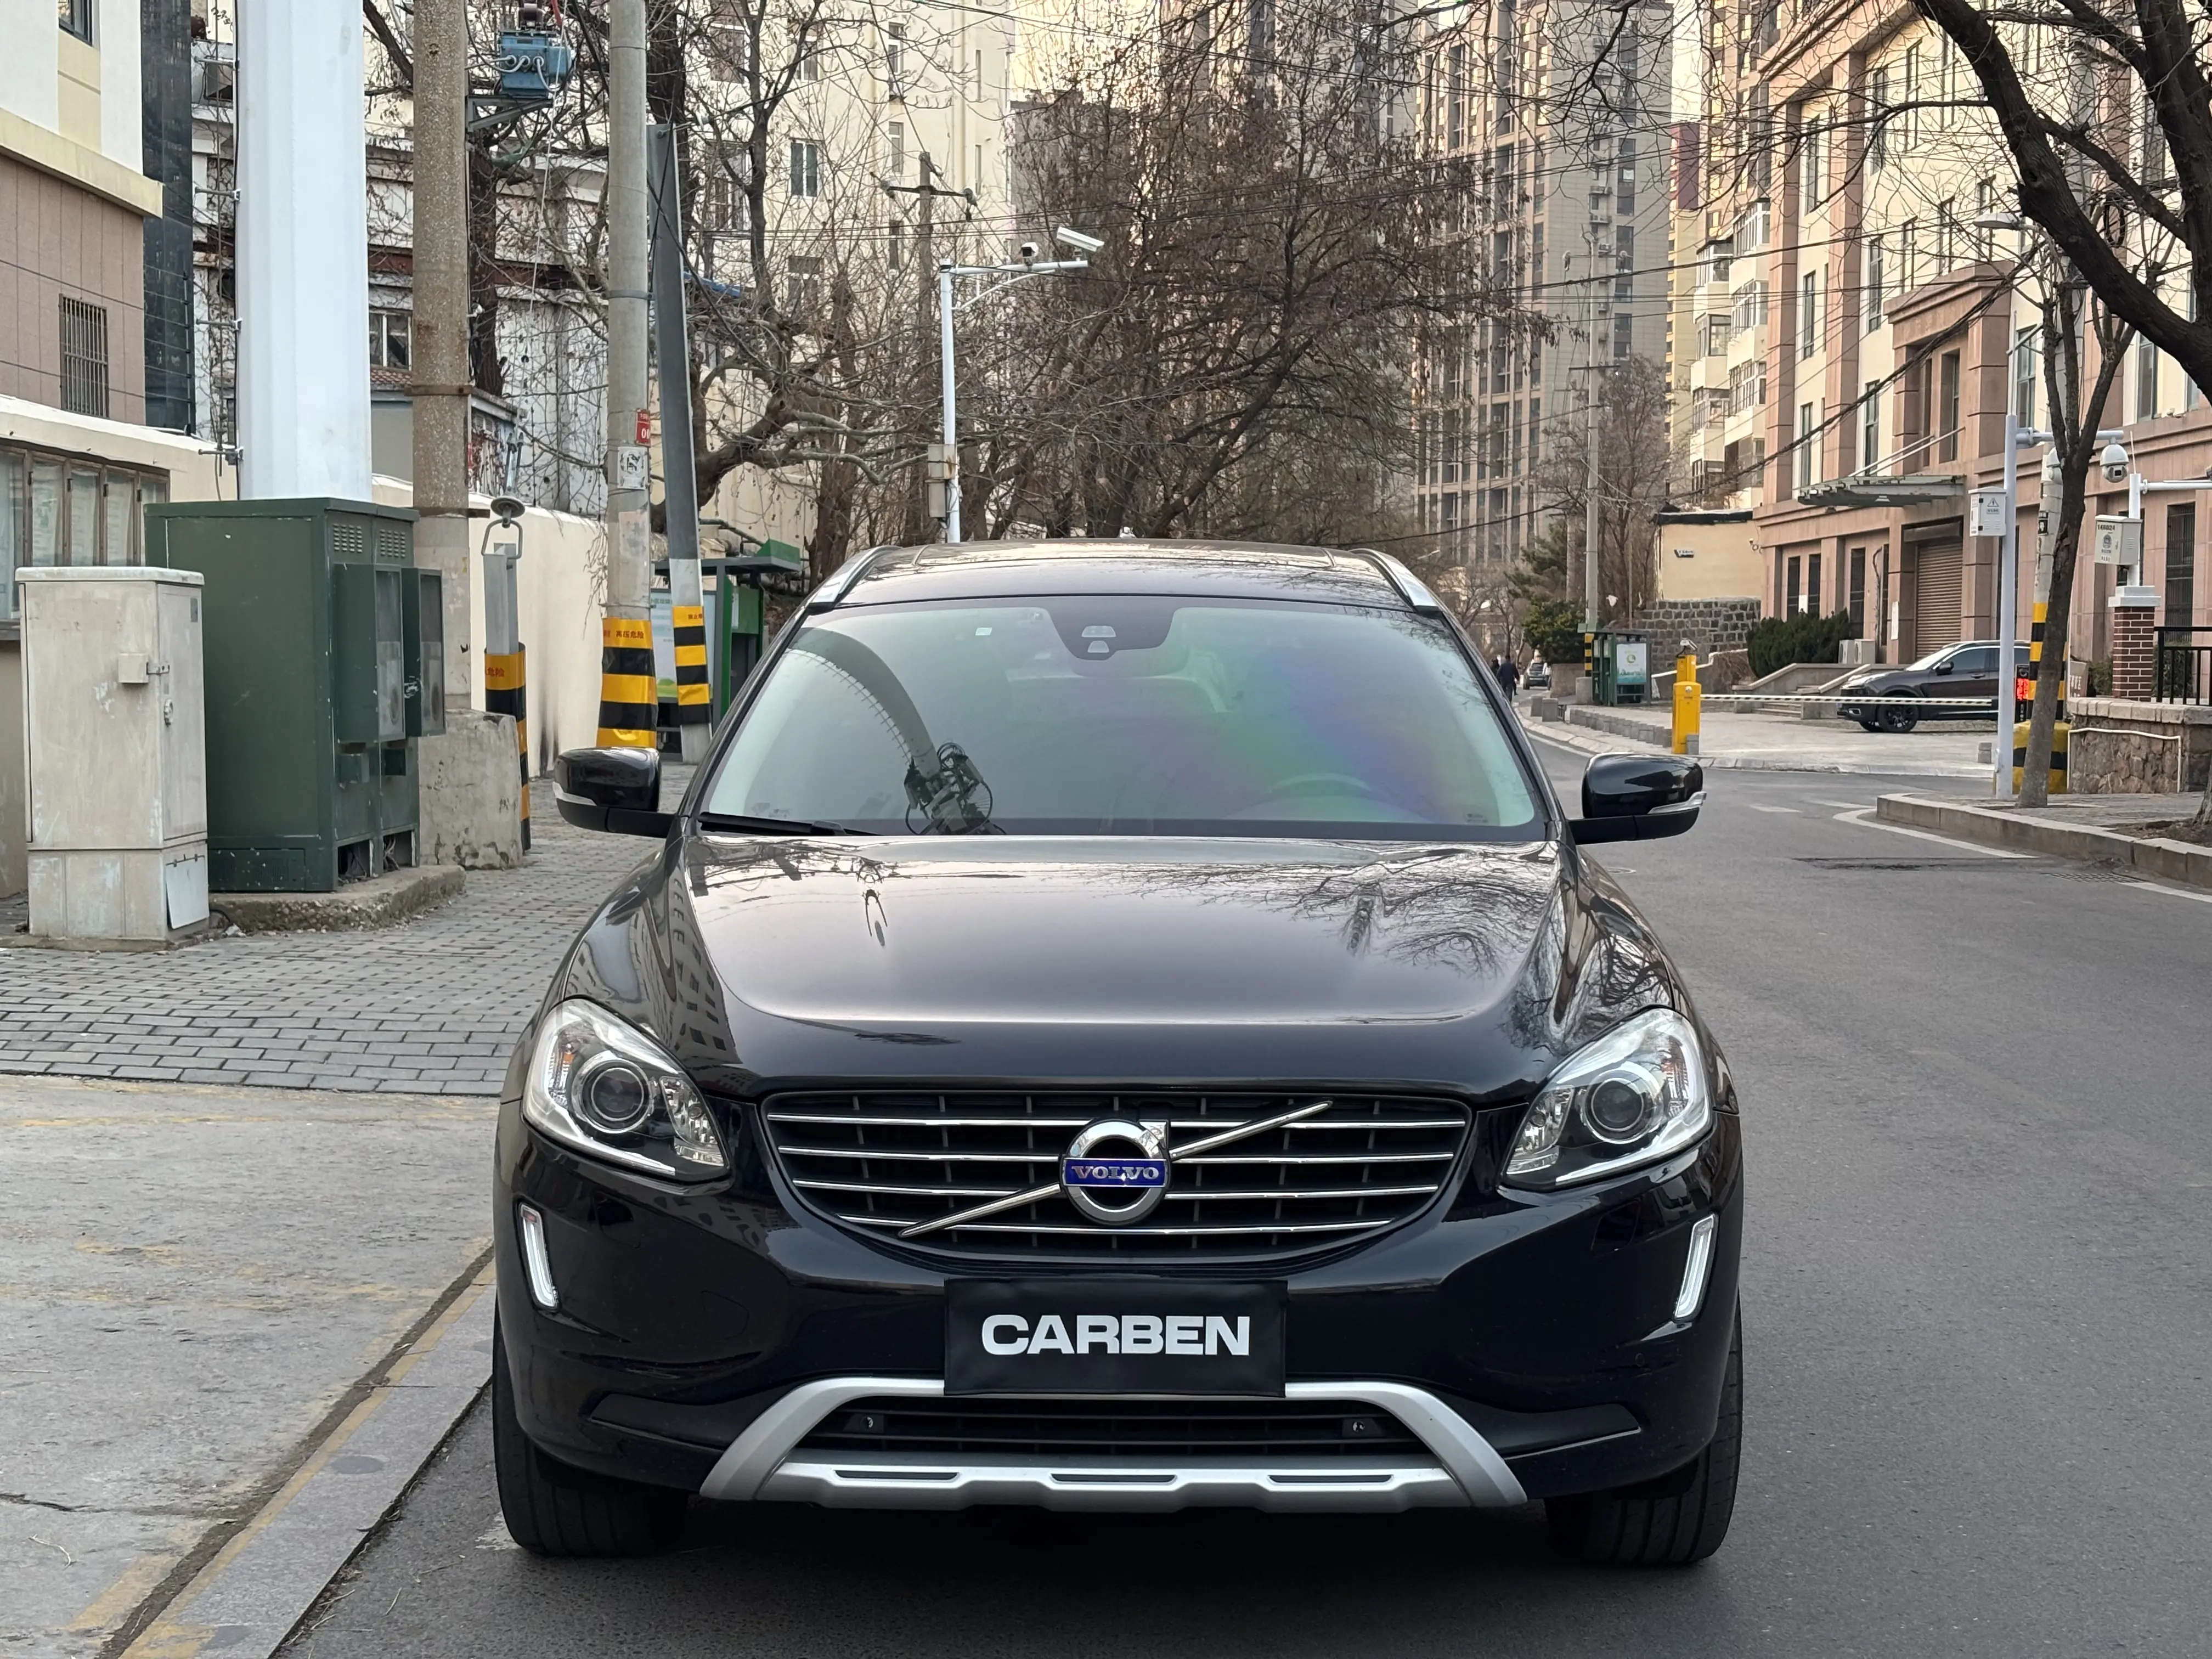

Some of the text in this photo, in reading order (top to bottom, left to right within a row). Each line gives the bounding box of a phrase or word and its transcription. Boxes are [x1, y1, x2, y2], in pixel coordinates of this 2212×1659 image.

[616, 630, 644, 639] 高压危险
[485, 667, 505, 678] 危险
[1071, 1165, 1159, 1180] VOLVO
[981, 1314, 1250, 1356] CARBEN
